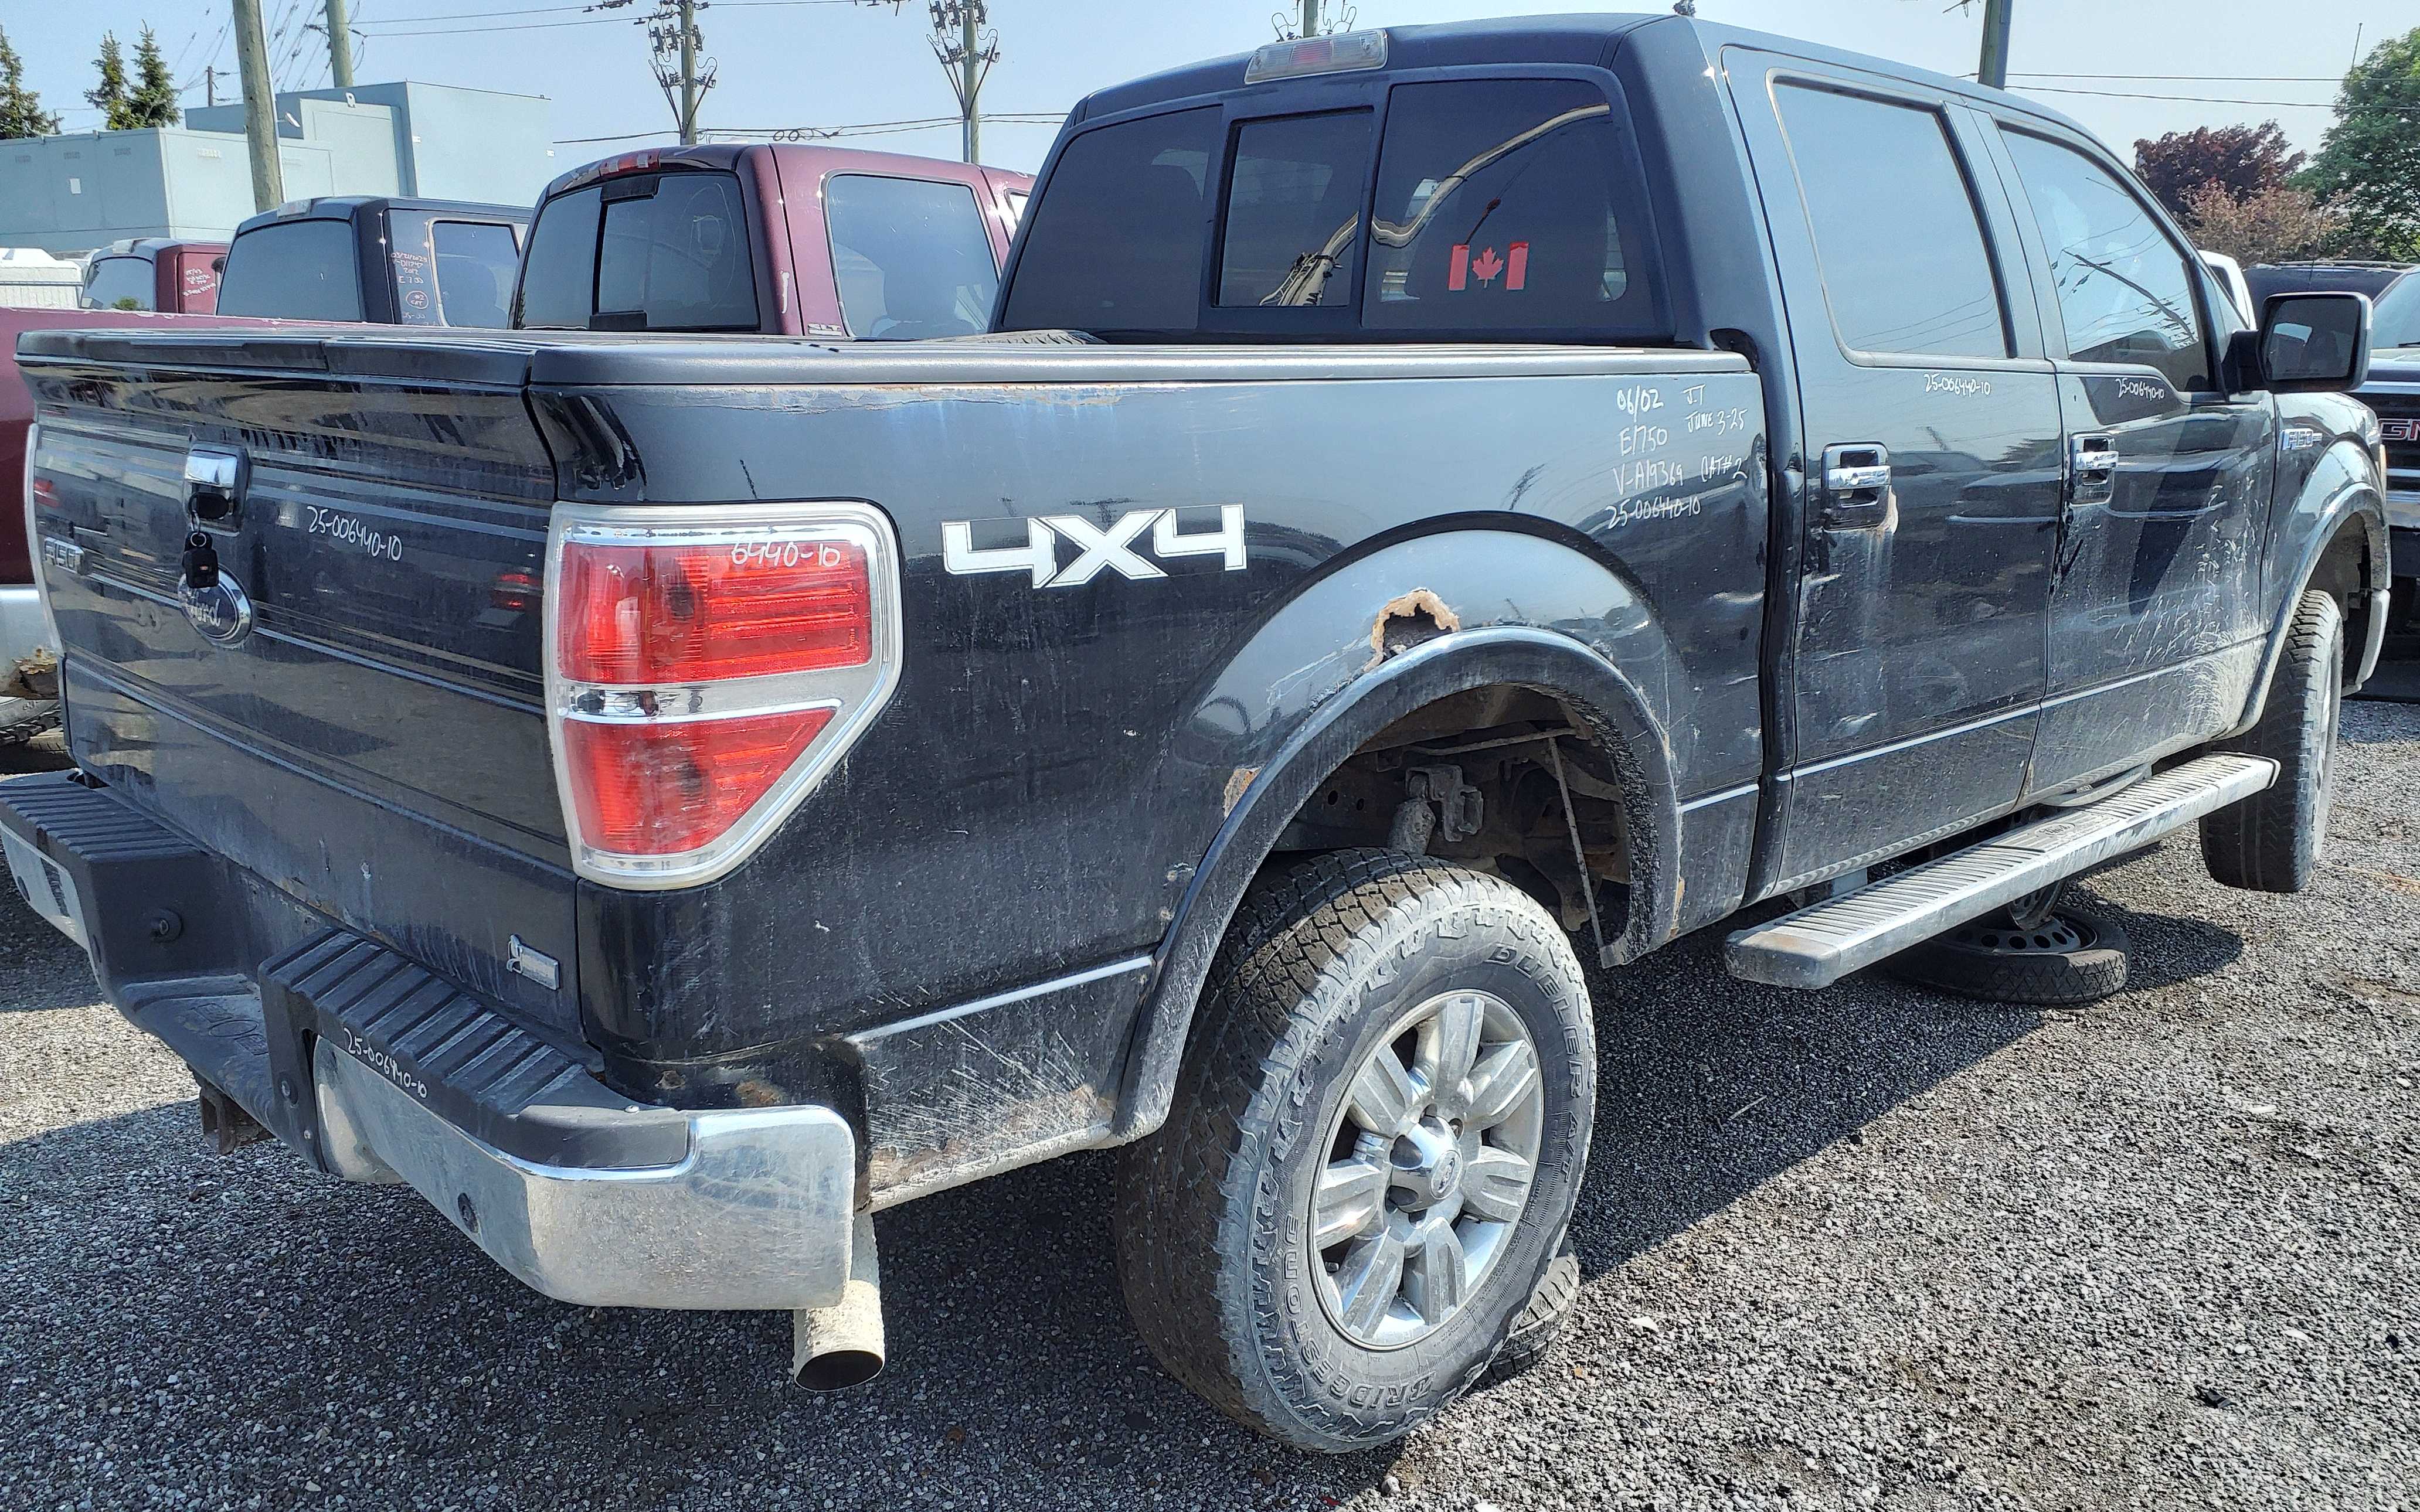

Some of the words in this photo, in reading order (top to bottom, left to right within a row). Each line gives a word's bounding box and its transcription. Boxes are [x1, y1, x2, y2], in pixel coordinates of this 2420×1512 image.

[1923, 373, 1991, 397] 25-006440-10
[2115, 377, 2164, 401] 25-006440-10
[1617, 384, 1664, 423] 06/02
[1685, 410, 1713, 433] JUNE
[1717, 407, 1748, 435] 3-25
[1613, 459, 1683, 495] V-A19369
[1605, 496, 1701, 529] 25-006440-10
[307, 506, 402, 561] 25-006440-10
[731, 540, 841, 567] 6440-10
[1483, 942, 1583, 1098] DUELER
[344, 1027, 427, 1098] 25-006440-10
[1282, 1214, 1436, 1408] BRIDGESTONE
